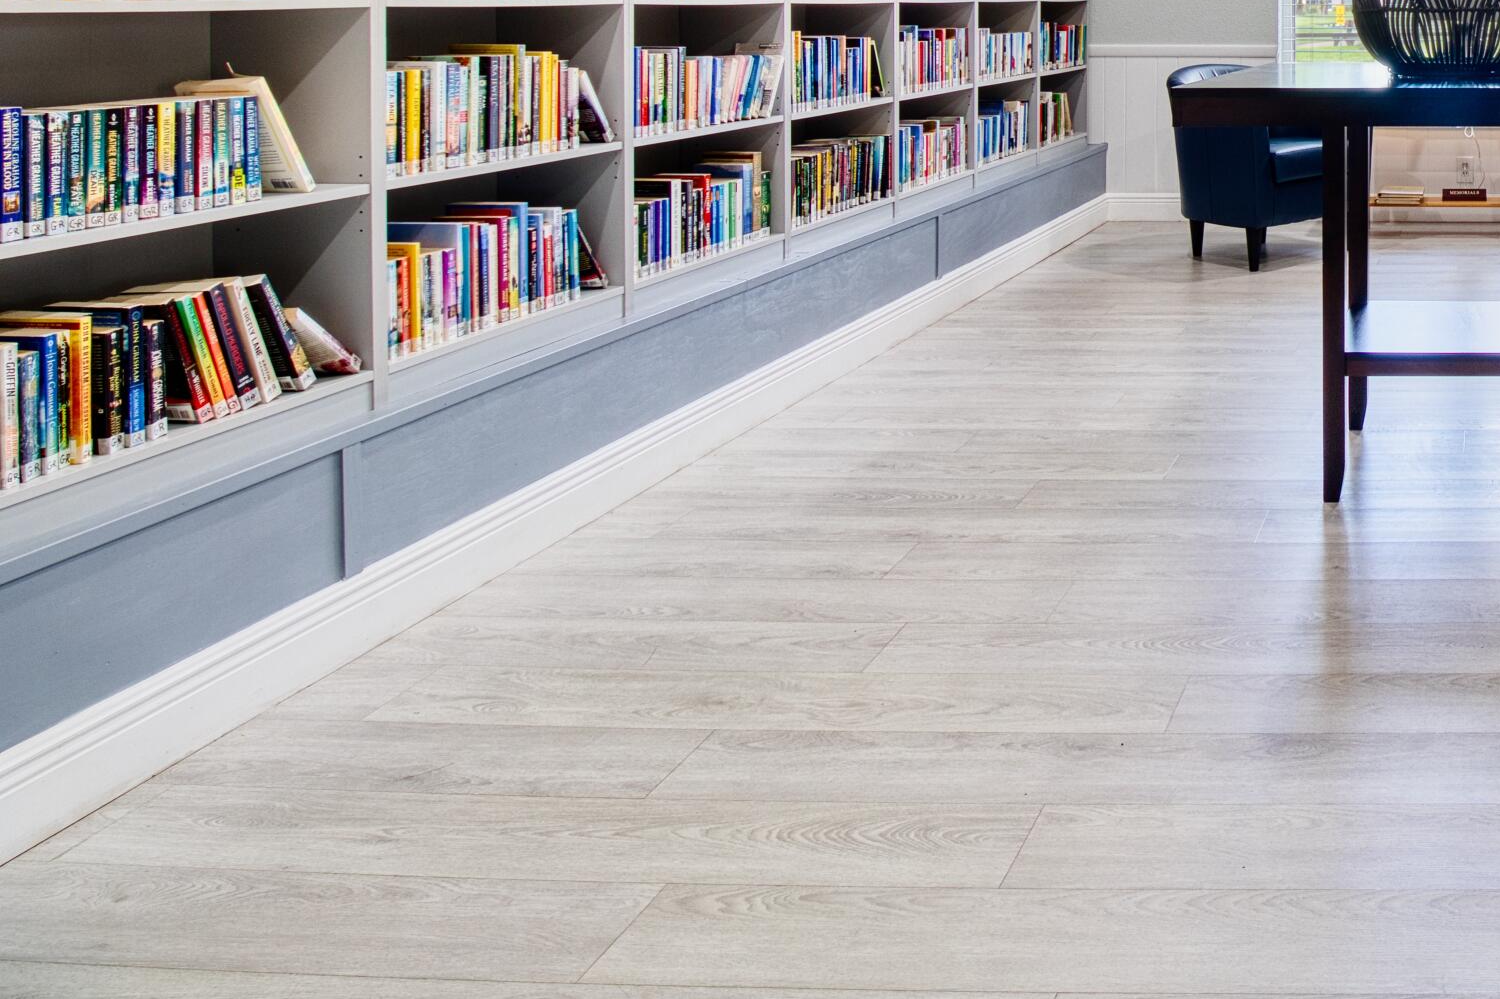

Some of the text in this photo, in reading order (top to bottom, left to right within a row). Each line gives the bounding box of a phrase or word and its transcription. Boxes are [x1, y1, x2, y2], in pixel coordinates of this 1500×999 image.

[2, 113, 12, 190] WRITTEN IN BLOOD
[11, 111, 20, 189] CAROLINE GRAHAM
[31, 130, 41, 195] HEATHER GRAHAM
[50, 132, 61, 196] HEATHER GRAHAM
[108, 130, 117, 183] HEATHER GRAHAM
[146, 123, 155, 175] HEATHER GRAHAM
[162, 118, 171, 172] HEATHER GRAHAM
[81, 321, 90, 384] JOHN GRISHAM
[132, 320, 141, 384] JOHN GRISHAM
[216, 302, 245, 377] APOLLO MURDERS
[242, 306, 263, 358] FIREFLY LANE
[5, 361, 16, 398] GRIFFIN
[46, 359, 57, 417] JOHN GRISHAM
[151, 349, 163, 413] JOHN GRISHAM
[192, 374, 206, 405] WHISTLER
